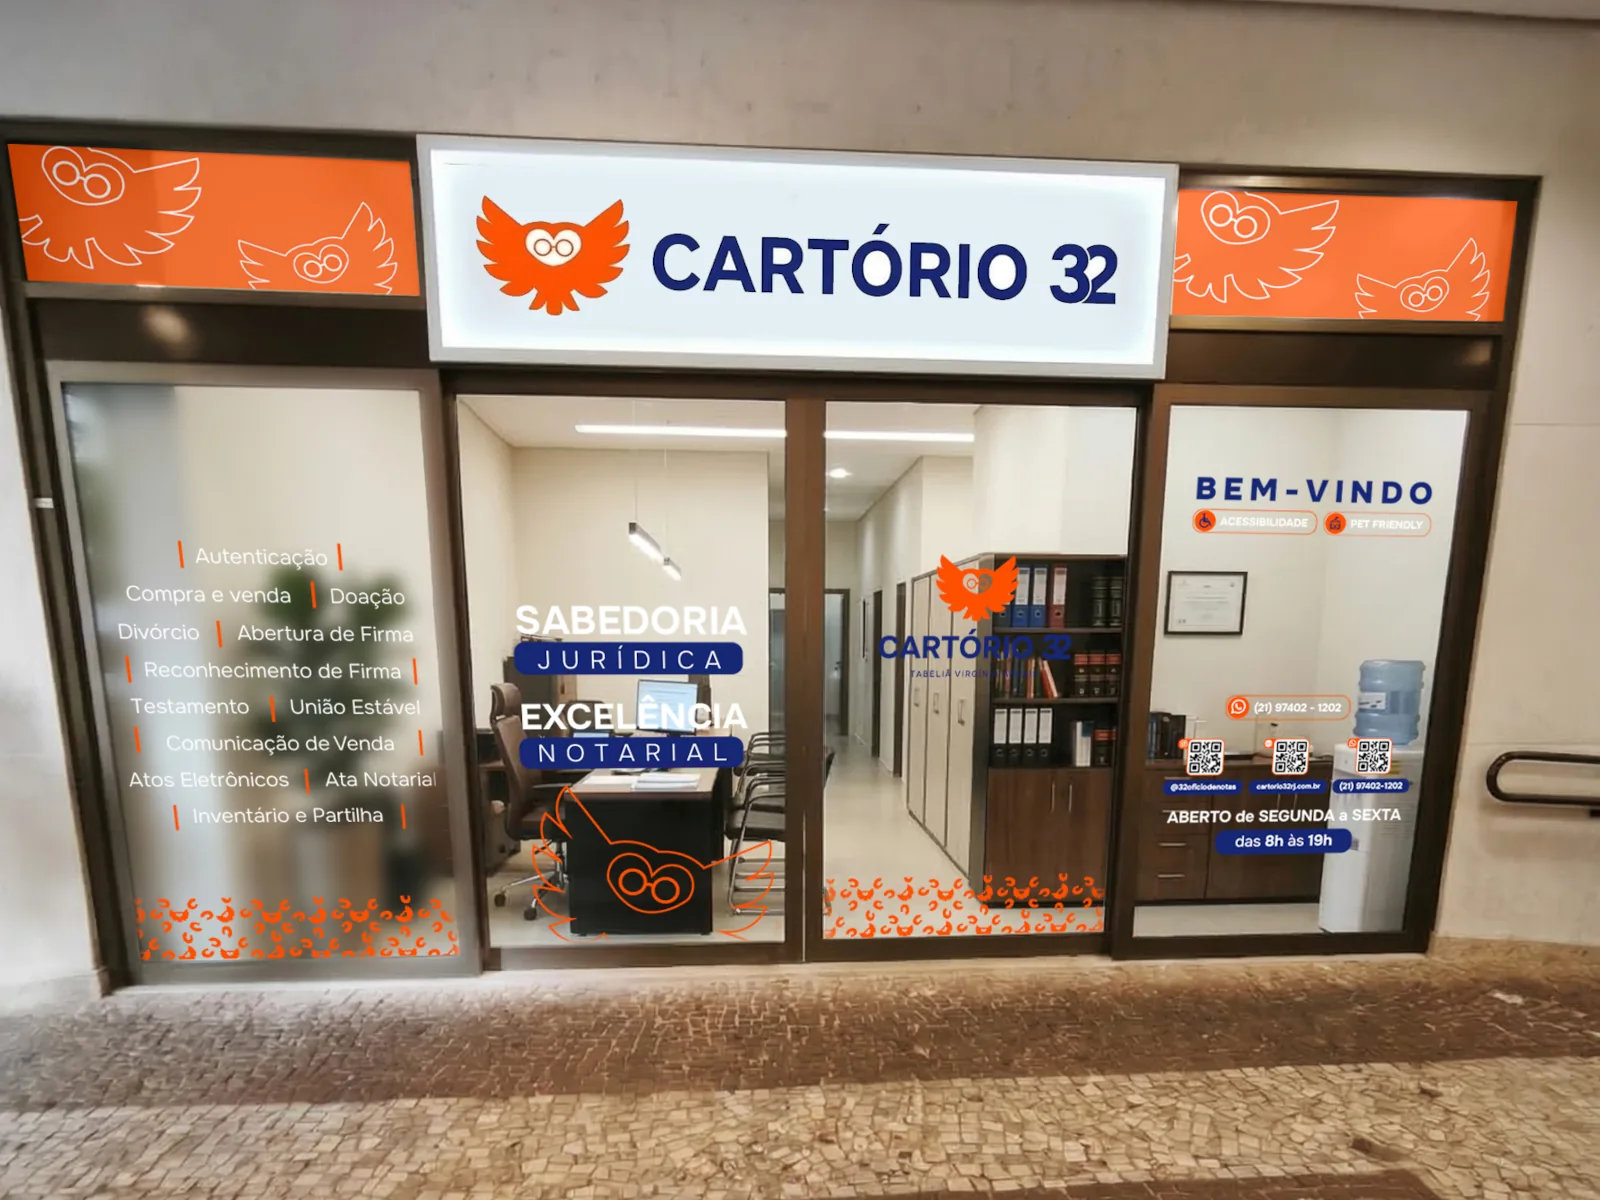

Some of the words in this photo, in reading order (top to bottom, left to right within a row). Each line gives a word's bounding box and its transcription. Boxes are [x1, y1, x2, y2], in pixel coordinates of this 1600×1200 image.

[652, 223, 1027, 300] CARTÓRIO
[1049, 243, 1118, 305] 32
[1196, 477, 1433, 504] BEM-VINDO
[1220, 516, 1309, 528] ACESSIBILIDADE
[1350, 519, 1370, 529] PET
[1372, 520, 1423, 530] FRIENDLY
[195, 548, 328, 570] Autenticação
[126, 585, 205, 605] Compra
[212, 591, 224, 602] e
[230, 587, 291, 603] venda
[331, 588, 405, 609] Doação
[516, 605, 747, 635] SABEDORIA
[118, 624, 199, 640] Divórcio
[238, 625, 324, 641] Abertura
[330, 626, 354, 641] de
[361, 626, 413, 642] Firma
[879, 629, 1033, 659] CARTÓRIO
[1042, 634, 1071, 660] 32
[537, 645, 721, 670] JURÍDICA
[144, 662, 312, 679] Reconhecimento
[318, 663, 342, 679] de
[349, 663, 401, 679] Firma
[130, 698, 249, 714] Testamento
[290, 699, 345, 715] União
[352, 698, 420, 715] Estável
[520, 695, 748, 730] EXCELÊNCIA
[1253, 703, 1272, 714] (21)
[1275, 703, 1307, 713] 97402
[1318, 703, 1342, 712] 1202
[166, 735, 299, 756] Comunicação
[306, 736, 329, 751] de
[334, 736, 395, 751] Venda
[538, 743, 727, 762] NOTARIAL
[129, 772, 174, 787] Atos
[181, 772, 289, 787] Eletrônicos
[326, 772, 358, 787] Ata
[364, 772, 436, 787] Notarial
[1256, 782, 1321, 791] cartorio32rj.com.br
[1339, 782, 1354, 791] (21)
[1356, 781, 1402, 790] 97402-1202
[193, 807, 289, 823] Inventário
[295, 811, 307, 822] e
[313, 807, 383, 823] Partilha
[1167, 810, 1231, 824] ABERTO
[1235, 810, 1253, 822] de
[1259, 809, 1335, 822] SEGUNDA
[1339, 812, 1348, 821] a
[1352, 808, 1401, 821] SEXTA
[1235, 836, 1261, 848] das
[1265, 836, 1283, 847] 8h
[1288, 835, 1304, 847] às
[1308, 834, 1332, 846] 19h
